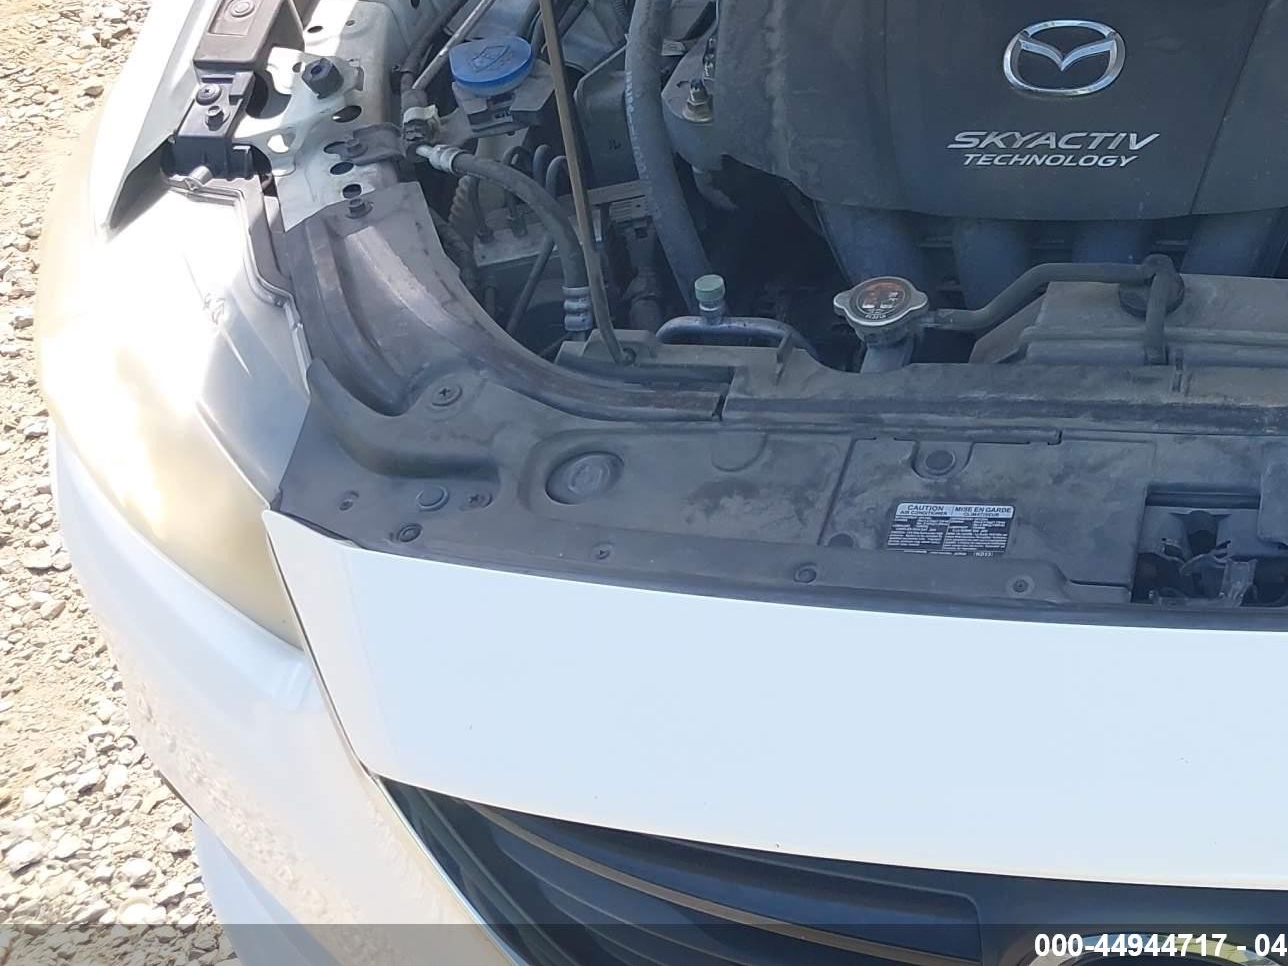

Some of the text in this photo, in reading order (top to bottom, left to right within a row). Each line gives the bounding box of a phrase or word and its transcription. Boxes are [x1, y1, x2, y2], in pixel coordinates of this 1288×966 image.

[947, 131, 1160, 150] SKYACTIV
[963, 153, 1138, 167] TECHNOLOGY
[907, 504, 944, 512] CAUTION
